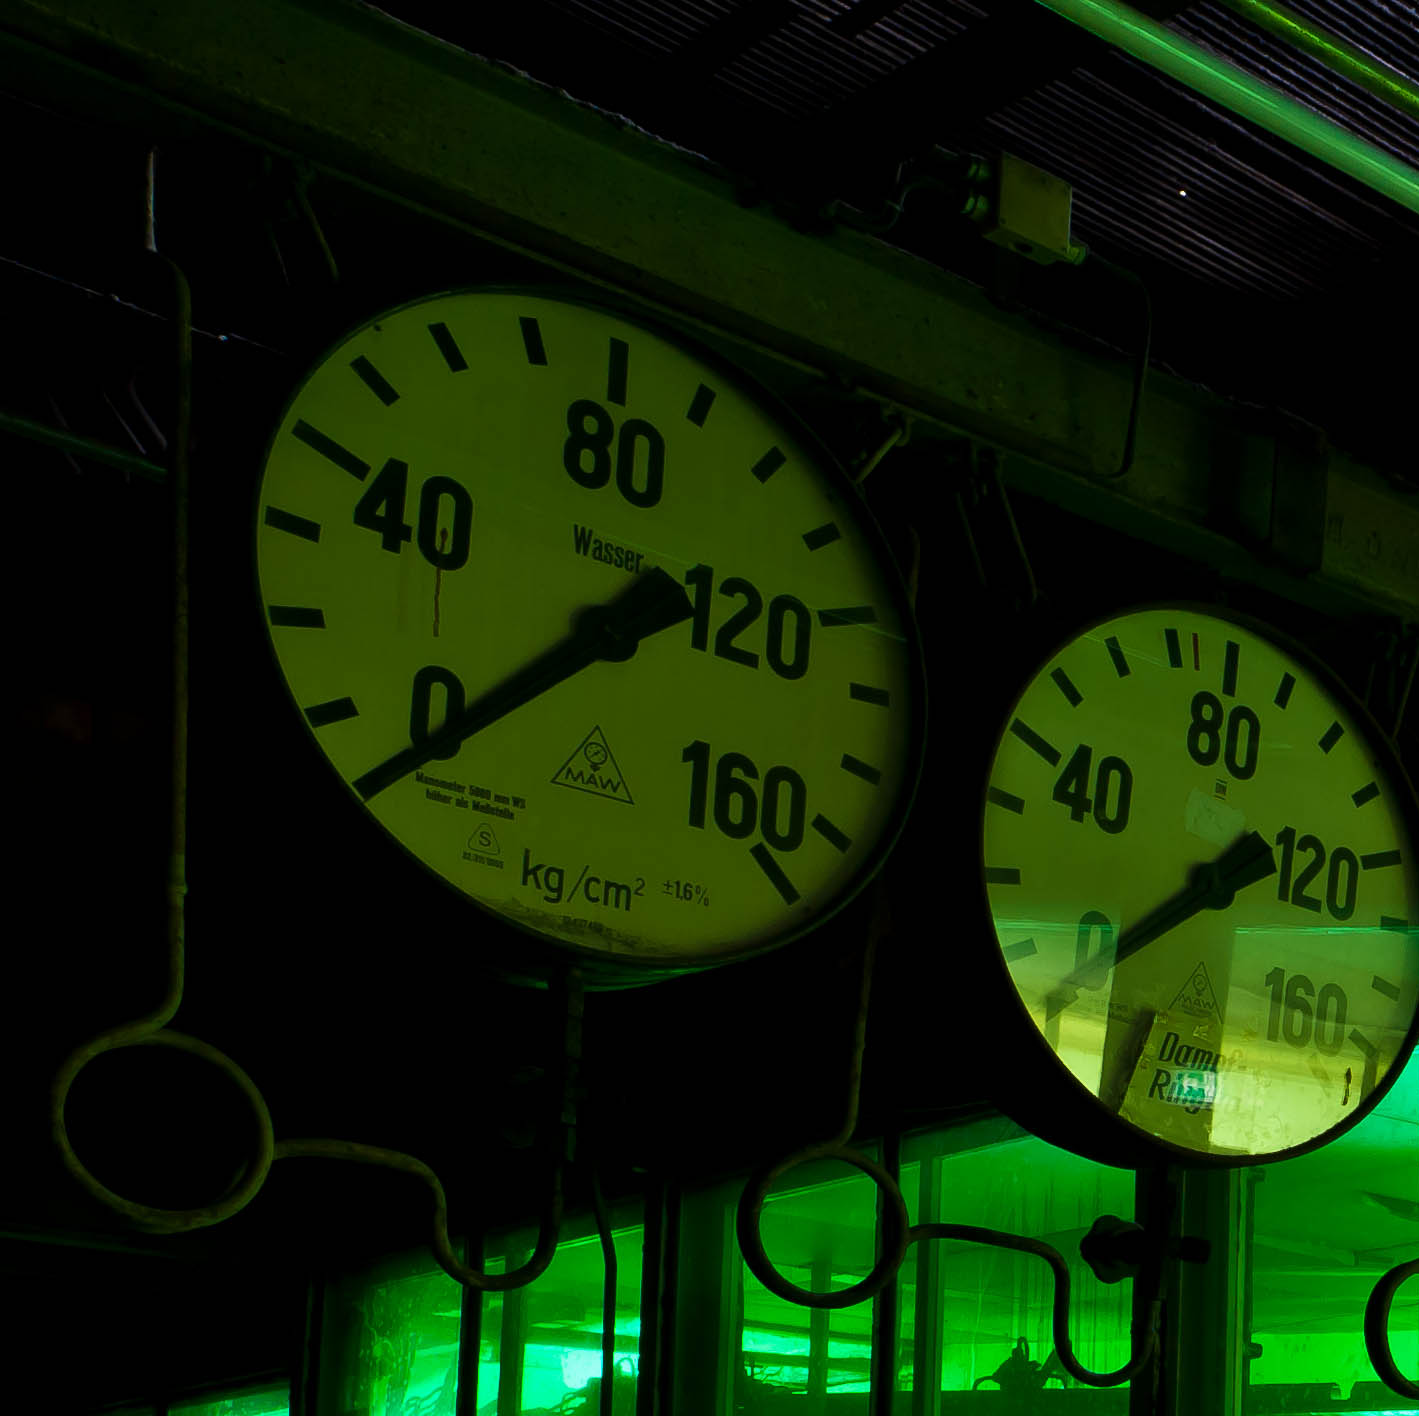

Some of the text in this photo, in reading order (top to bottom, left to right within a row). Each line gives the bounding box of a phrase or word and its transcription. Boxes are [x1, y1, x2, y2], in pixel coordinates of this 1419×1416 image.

[563, 400, 666, 509] 80
[353, 457, 474, 571] 40
[573, 523, 645, 576] Wasser
[684, 563, 812, 681] 120
[409, 665, 466, 761] 0
[1187, 691, 1261, 780] 80
[564, 767, 621, 794] MAW
[682, 740, 808, 852] 160
[1052, 744, 1133, 834] 40
[479, 830, 492, 848] S
[1274, 826, 1359, 921] 120
[1074, 910, 1113, 991] 0
[1264, 967, 1348, 1056] 160
